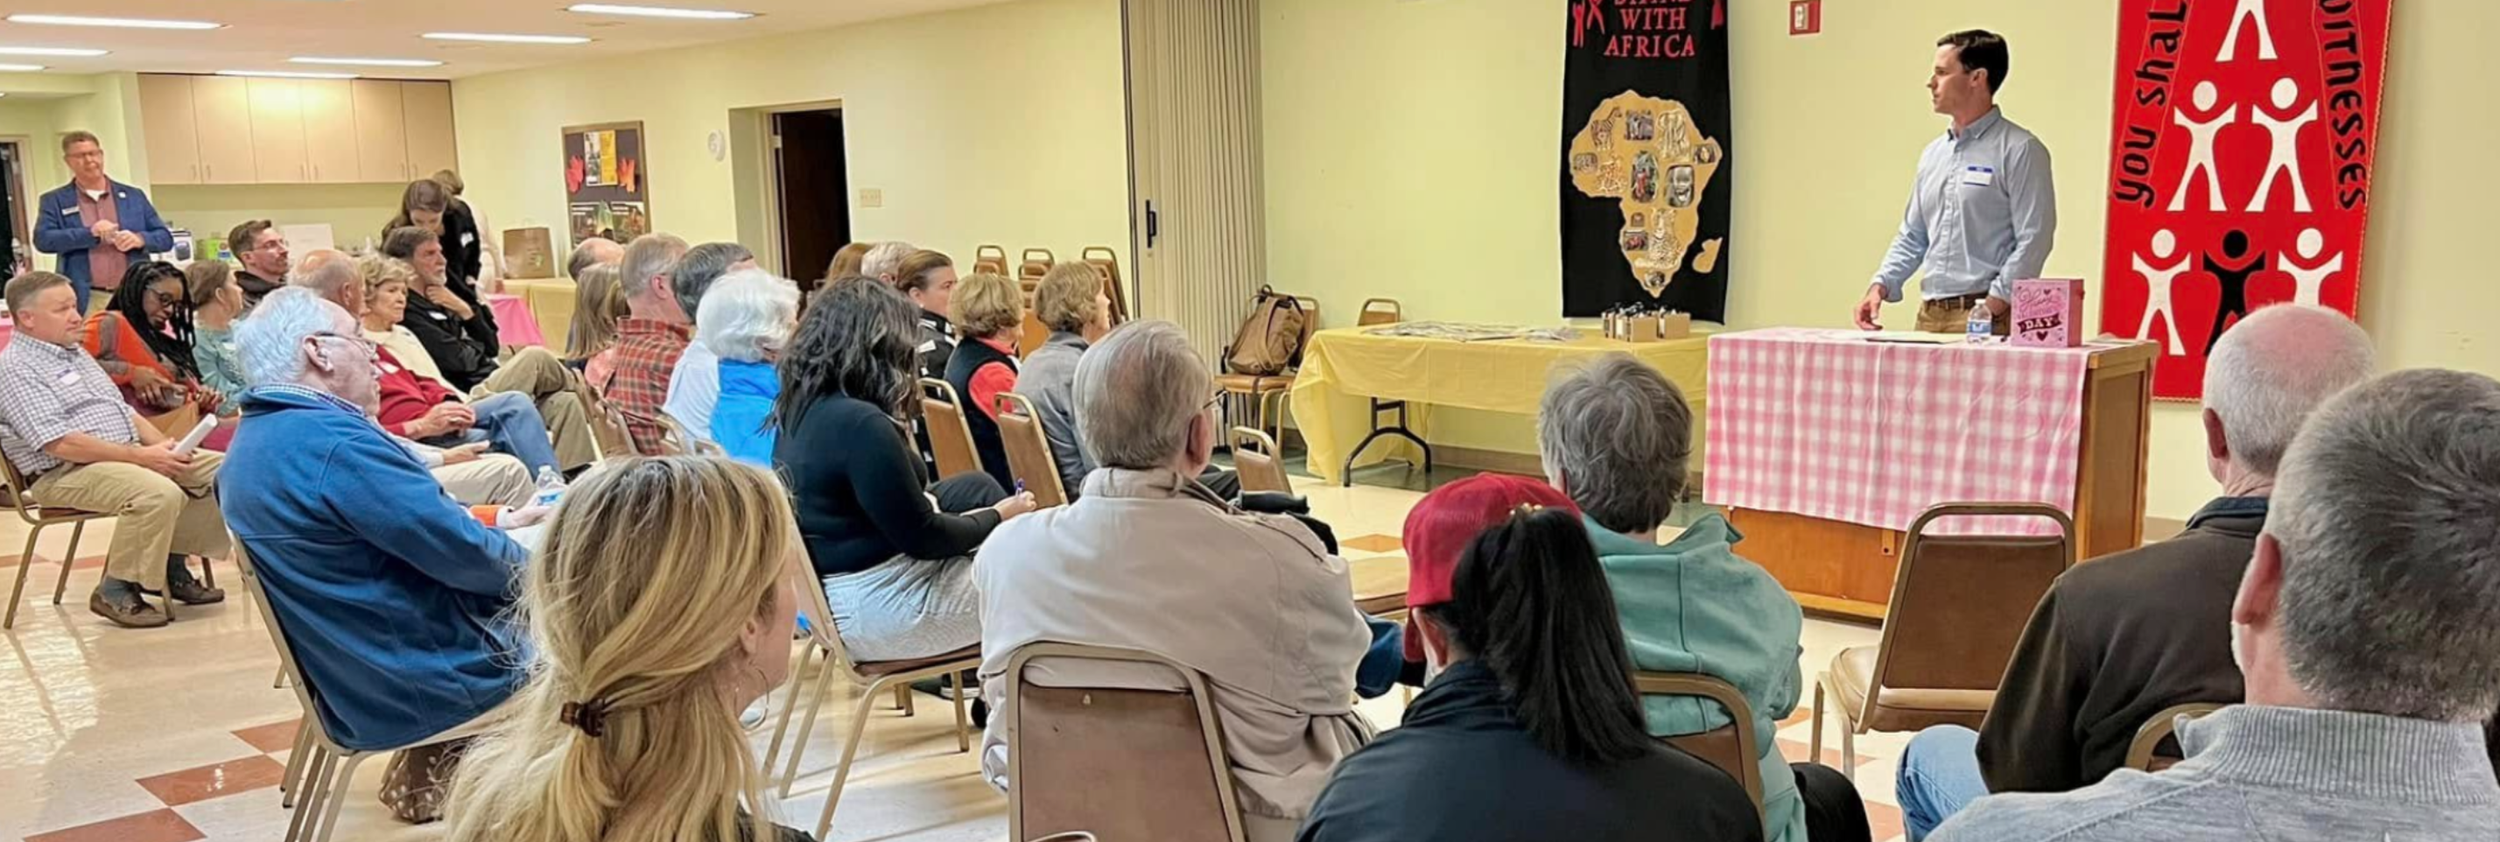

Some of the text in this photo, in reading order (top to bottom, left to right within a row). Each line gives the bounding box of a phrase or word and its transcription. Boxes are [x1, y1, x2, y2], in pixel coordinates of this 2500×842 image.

[1619, 7, 1687, 30] WITH
[1602, 33, 1696, 58] AFRICA
[2114, 125, 2156, 209] you
[2025, 316, 2054, 330] DAY
